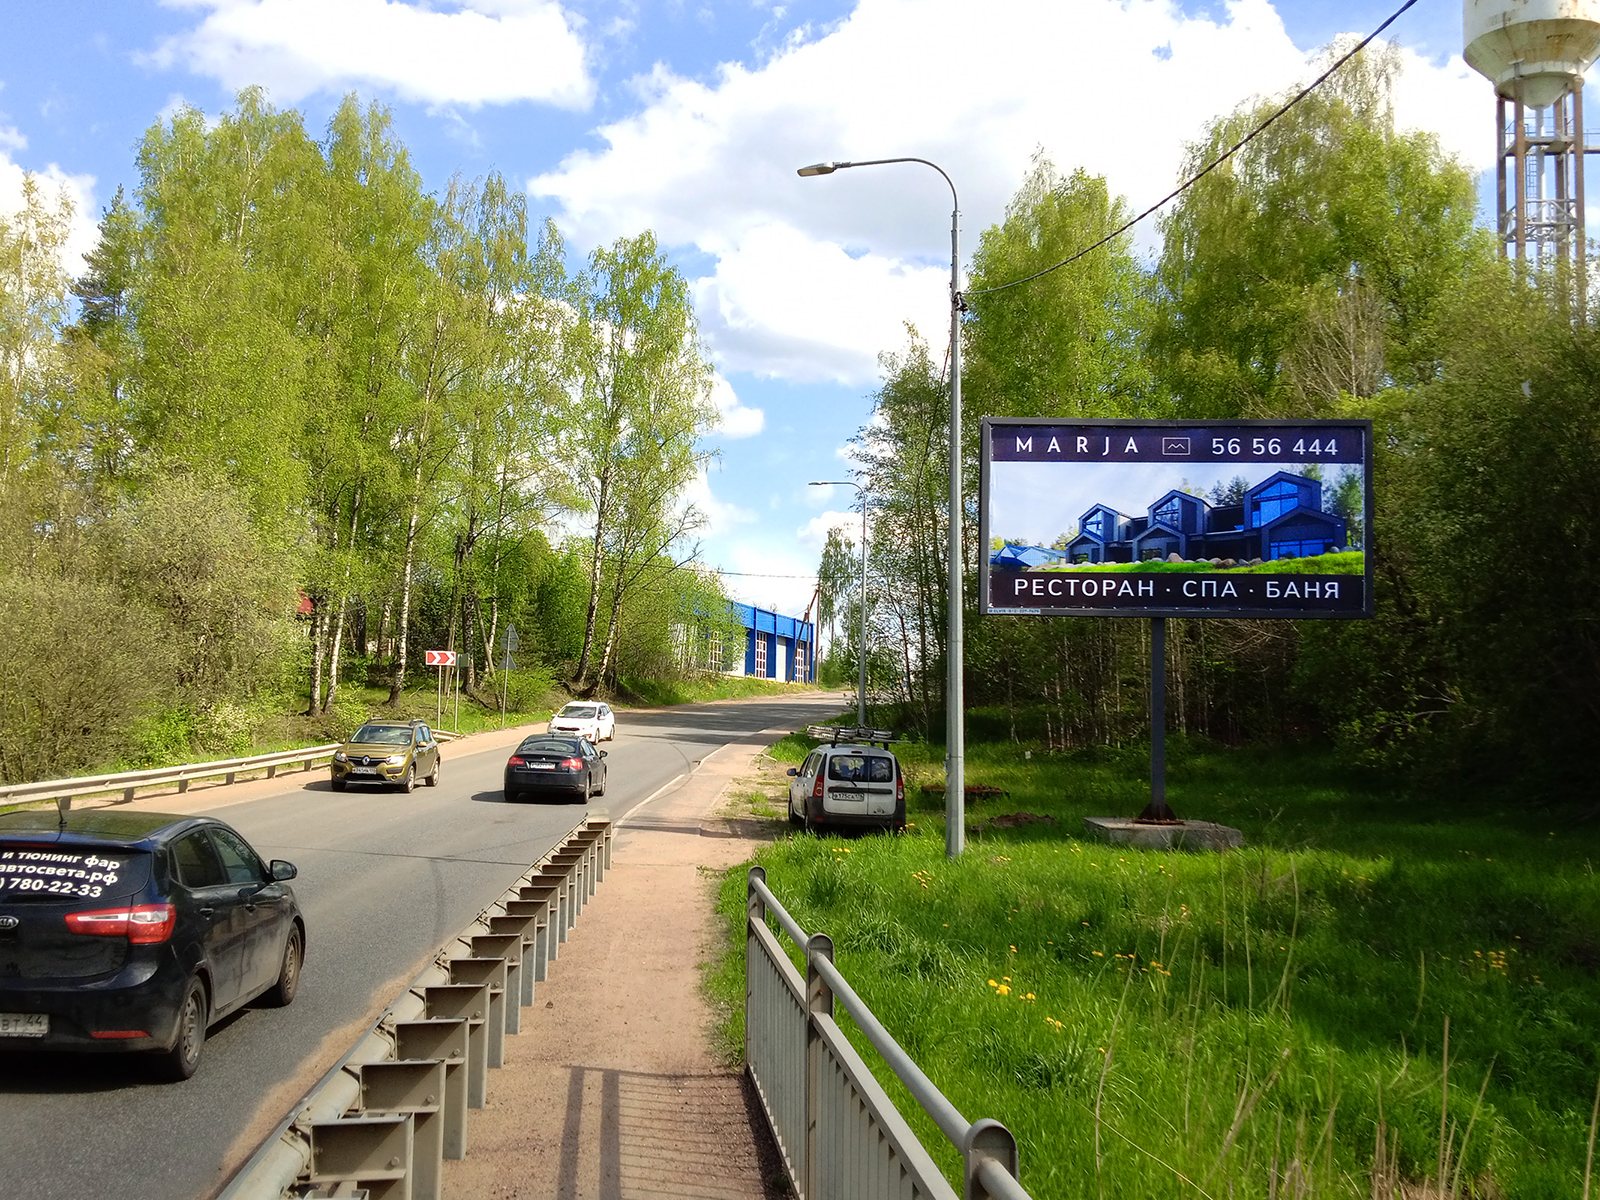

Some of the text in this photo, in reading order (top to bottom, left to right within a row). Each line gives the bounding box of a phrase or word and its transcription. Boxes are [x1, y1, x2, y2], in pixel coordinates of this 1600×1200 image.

[1016, 436, 1338, 456] MARJA 56 56 444
[1014, 579, 1339, 599] РЕСТОРАН СПА БАНЯ
[18, 852, 82, 863] тюнинг
[84, 855, 120, 871] фар
[8, 877, 102, 898] 780-22-33
